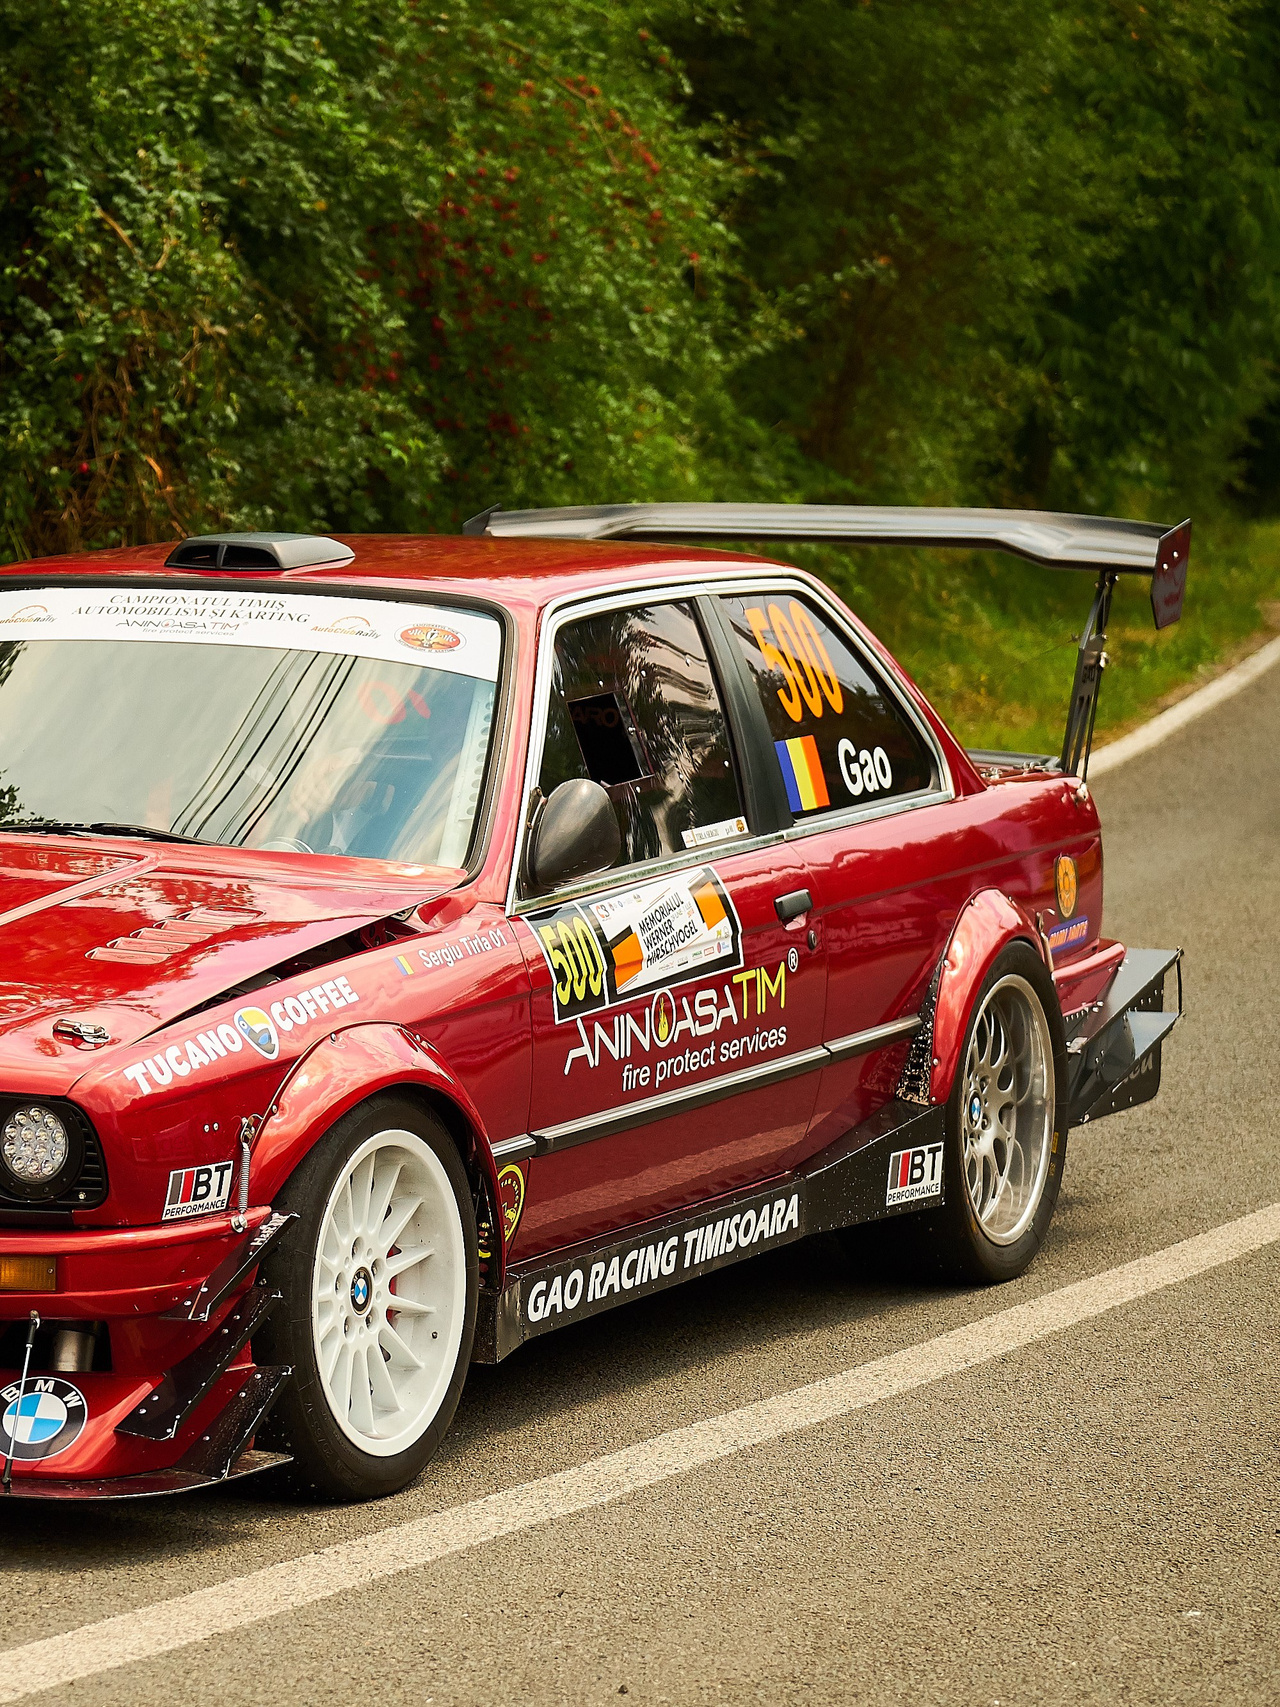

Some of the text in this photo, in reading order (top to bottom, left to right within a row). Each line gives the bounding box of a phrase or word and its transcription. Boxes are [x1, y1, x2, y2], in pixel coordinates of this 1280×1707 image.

[71, 606, 207, 617] AUTOMOBILISM
[228, 609, 310, 623] KARTING
[110, 594, 233, 607] CAMPIONATUL
[195, 629, 235, 637] services
[311, 625, 382, 640] AutoClubRally
[745, 600, 843, 723] 500
[838, 738, 893, 796] Gao
[638, 892, 684, 937] MEMORIALUL
[643, 919, 675, 951] WERNER
[418, 927, 508, 968] Sergiu Tirla 01
[538, 916, 604, 1005] 500
[646, 919, 698, 968] HIRSCHVOGEL
[122, 975, 360, 1095] TUCANO COFFEE
[622, 1026, 787, 1092] fire protect services
[164, 1198, 226, 1217] PERFORMANCE
[887, 1183, 939, 1203] PERFORMANCE
[527, 1194, 799, 1323] GAO RACING TIMISOARA
[1, 1380, 82, 1408] BMW
